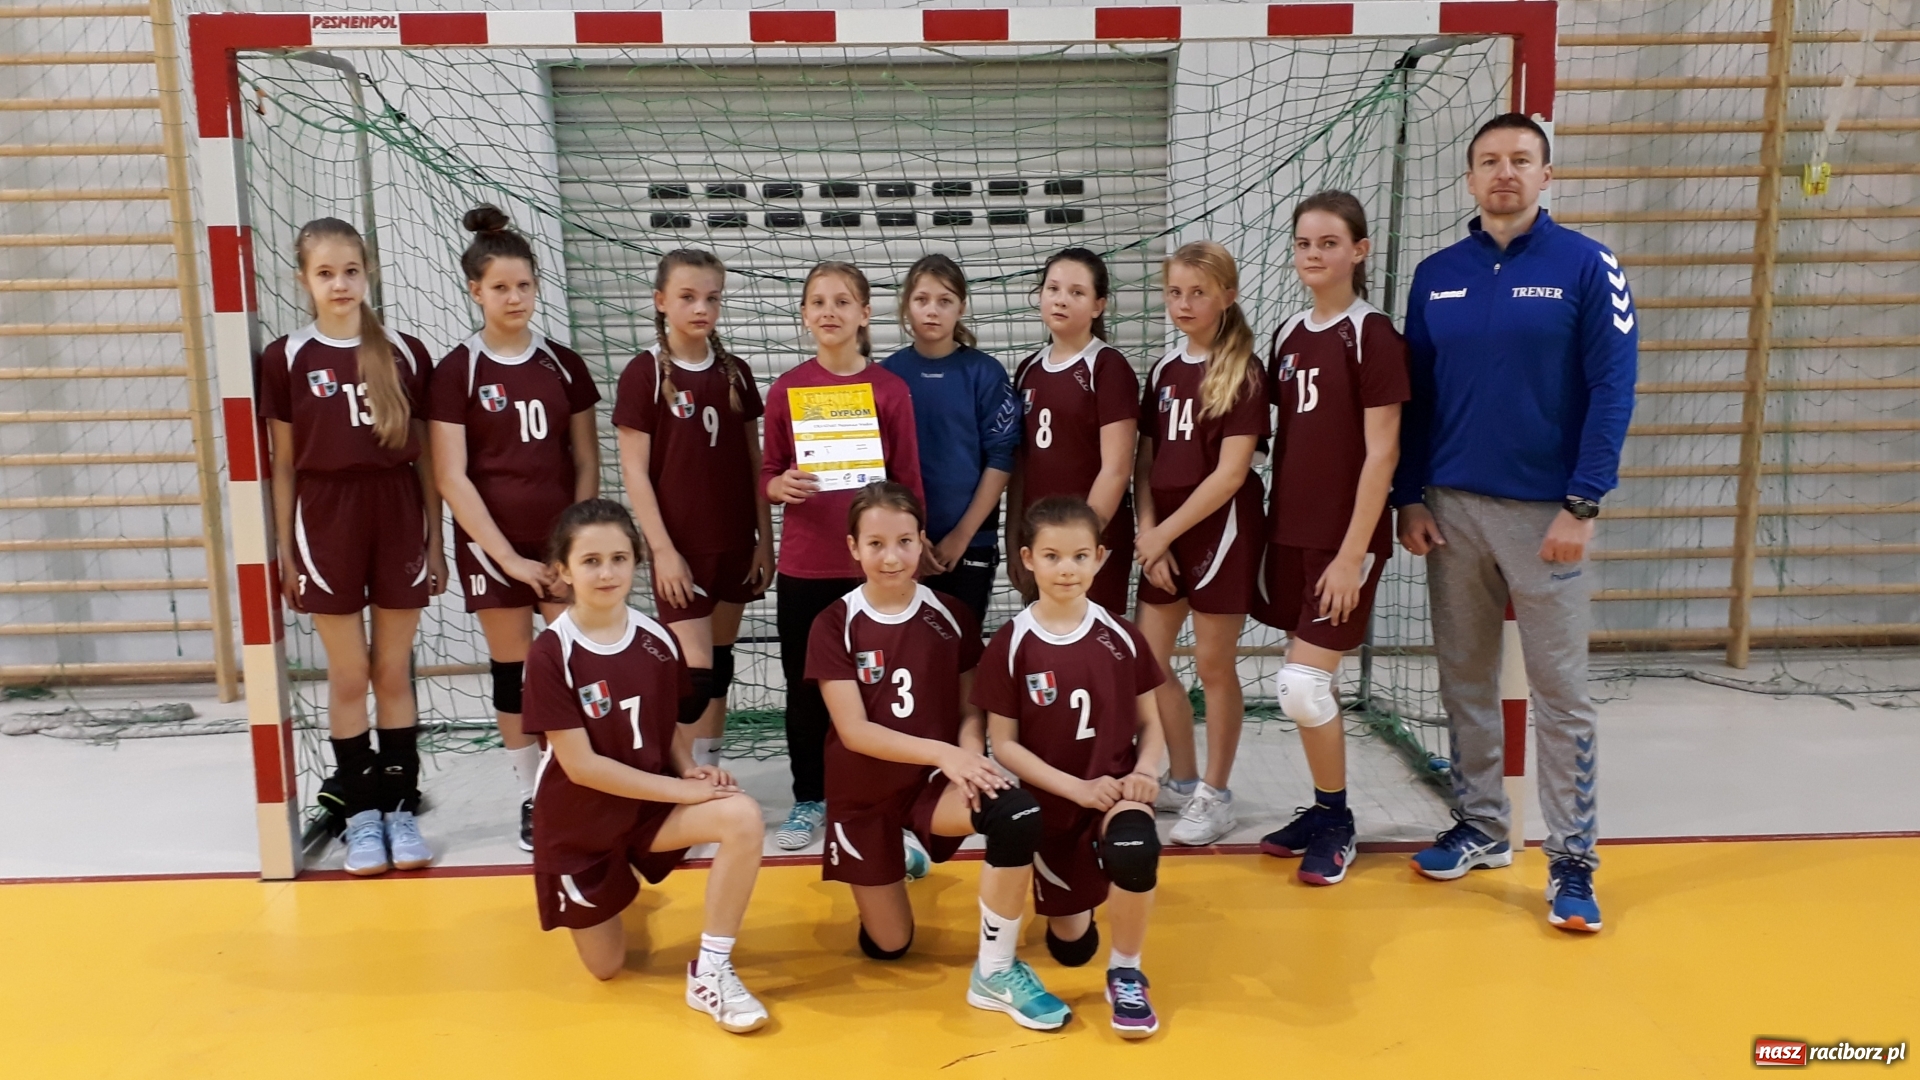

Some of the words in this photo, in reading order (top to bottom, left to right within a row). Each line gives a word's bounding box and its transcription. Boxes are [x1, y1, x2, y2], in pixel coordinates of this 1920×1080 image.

[312, 15, 398, 29] PESMENPOL
[1511, 286, 1564, 300] TRENER
[341, 382, 377, 427] 13
[1296, 367, 1320, 414] 15
[514, 398, 549, 443] 10
[702, 405, 720, 447] 9
[830, 408, 872, 418] DYPLOM
[1035, 407, 1053, 449] 8
[1167, 398, 1194, 441] 14
[298, 574, 307, 595] 3
[469, 573, 487, 596] 10
[890, 667, 915, 719] 3
[618, 695, 641, 750] 7
[1069, 688, 1096, 741] 2
[829, 841, 839, 866] 3
